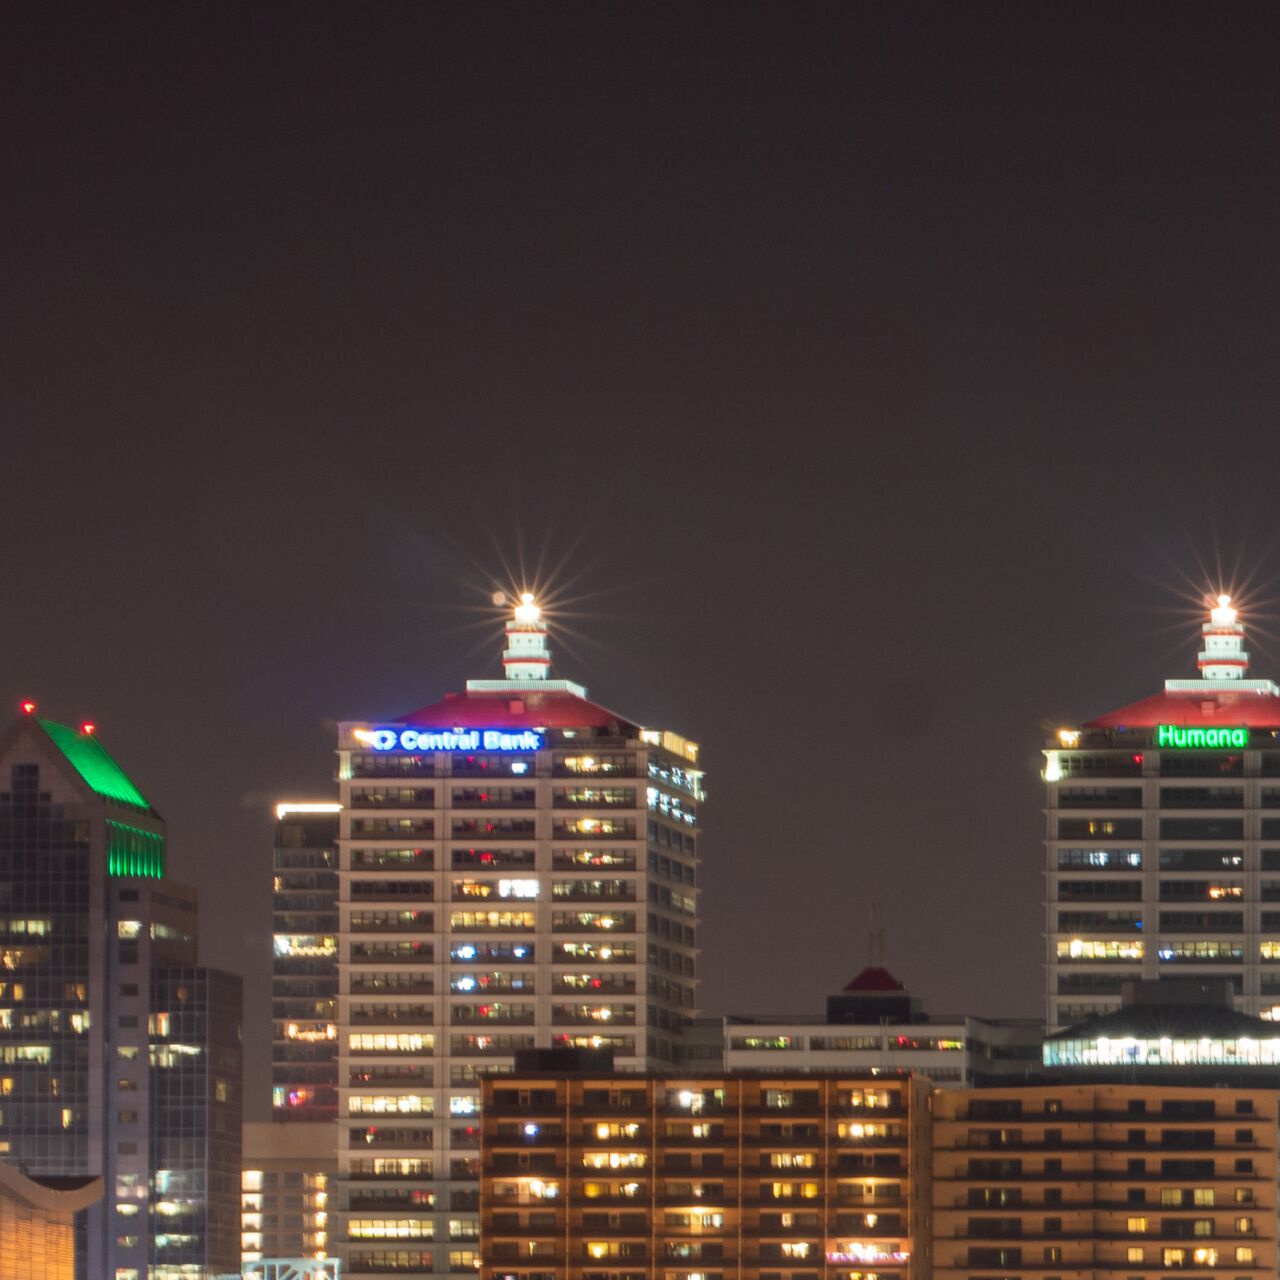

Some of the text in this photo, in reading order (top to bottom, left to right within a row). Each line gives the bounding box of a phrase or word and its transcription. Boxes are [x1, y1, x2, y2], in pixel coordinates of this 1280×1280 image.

[400, 730, 540, 750] Central Bank
[1158, 724, 1248, 749] Humana
